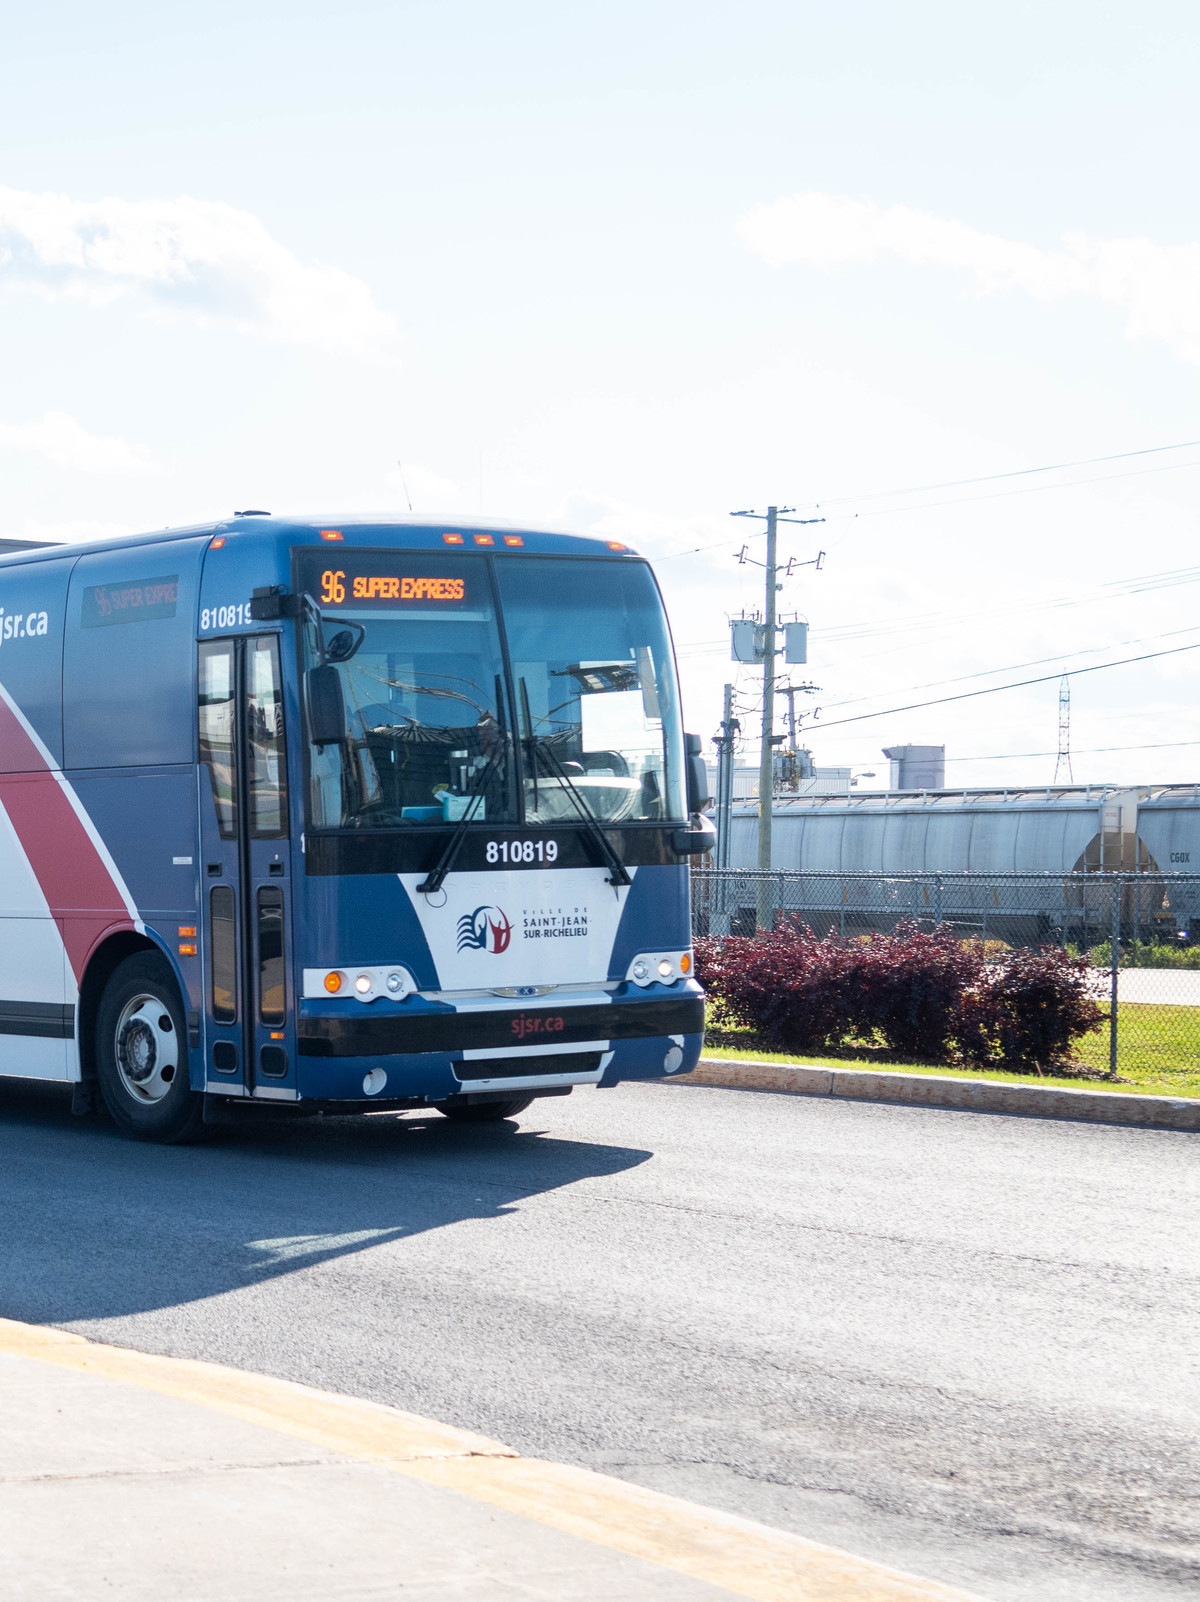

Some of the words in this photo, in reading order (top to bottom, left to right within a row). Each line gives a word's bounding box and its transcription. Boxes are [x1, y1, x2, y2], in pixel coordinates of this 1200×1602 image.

[321, 570, 346, 603] 96
[353, 576, 400, 598] SUPER
[401, 577, 465, 599] EXPRESS
[112, 587, 145, 611] SUPER
[486, 840, 558, 863] 810819
[1170, 852, 1190, 863] CGOX
[523, 907, 563, 915] VILLE
[523, 916, 593, 927] SAINT-JEAN-
[523, 927, 588, 938] SUR-RICHELIEU
[511, 1013, 564, 1038] sjsr.ca
